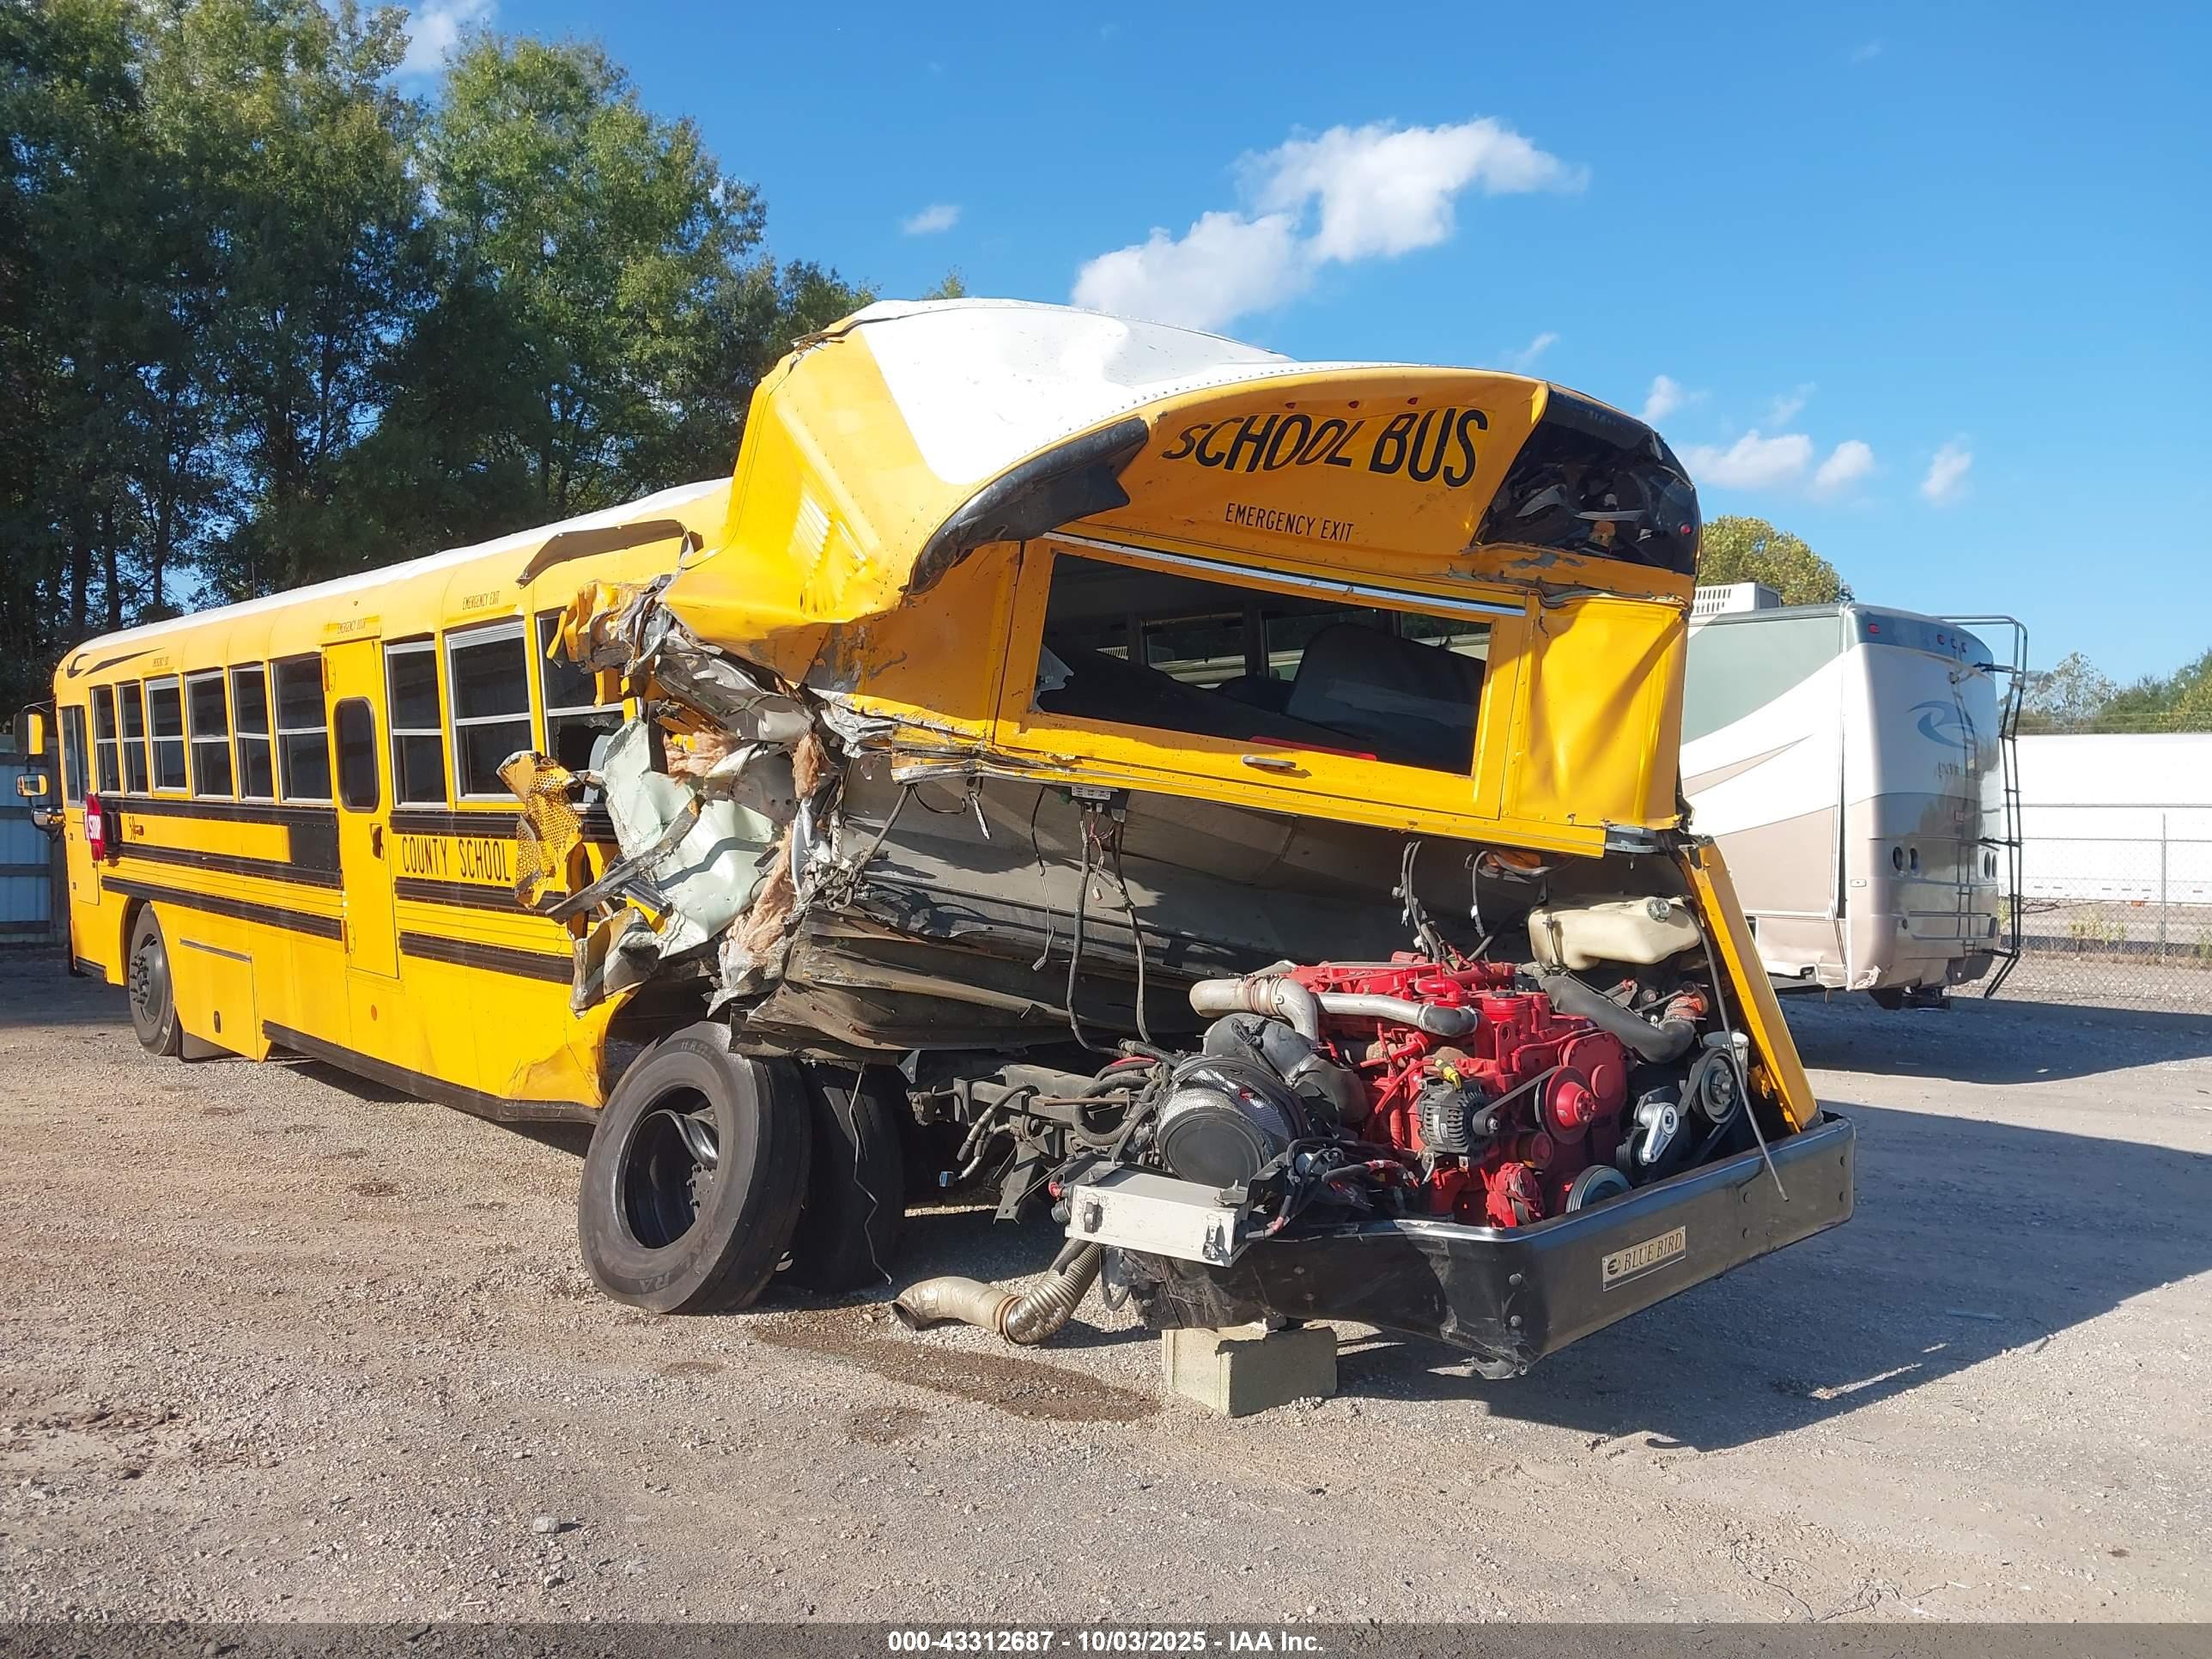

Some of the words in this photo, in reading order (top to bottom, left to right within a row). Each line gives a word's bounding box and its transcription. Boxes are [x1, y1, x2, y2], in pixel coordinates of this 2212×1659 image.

[1161, 414, 1366, 472] SCHOOL
[1369, 407, 1488, 488] BUS
[1225, 502, 1316, 537] EMERGENCY
[1321, 520, 1354, 543] EXIT
[462, 592, 489, 611] EMERGENCY
[489, 590, 501, 605] EXIT
[402, 836, 447, 876] COUNTY
[458, 838, 511, 882] SCHOOL
[1624, 1243, 1654, 1271] BLUE
[1656, 1232, 1682, 1258] BIRD
